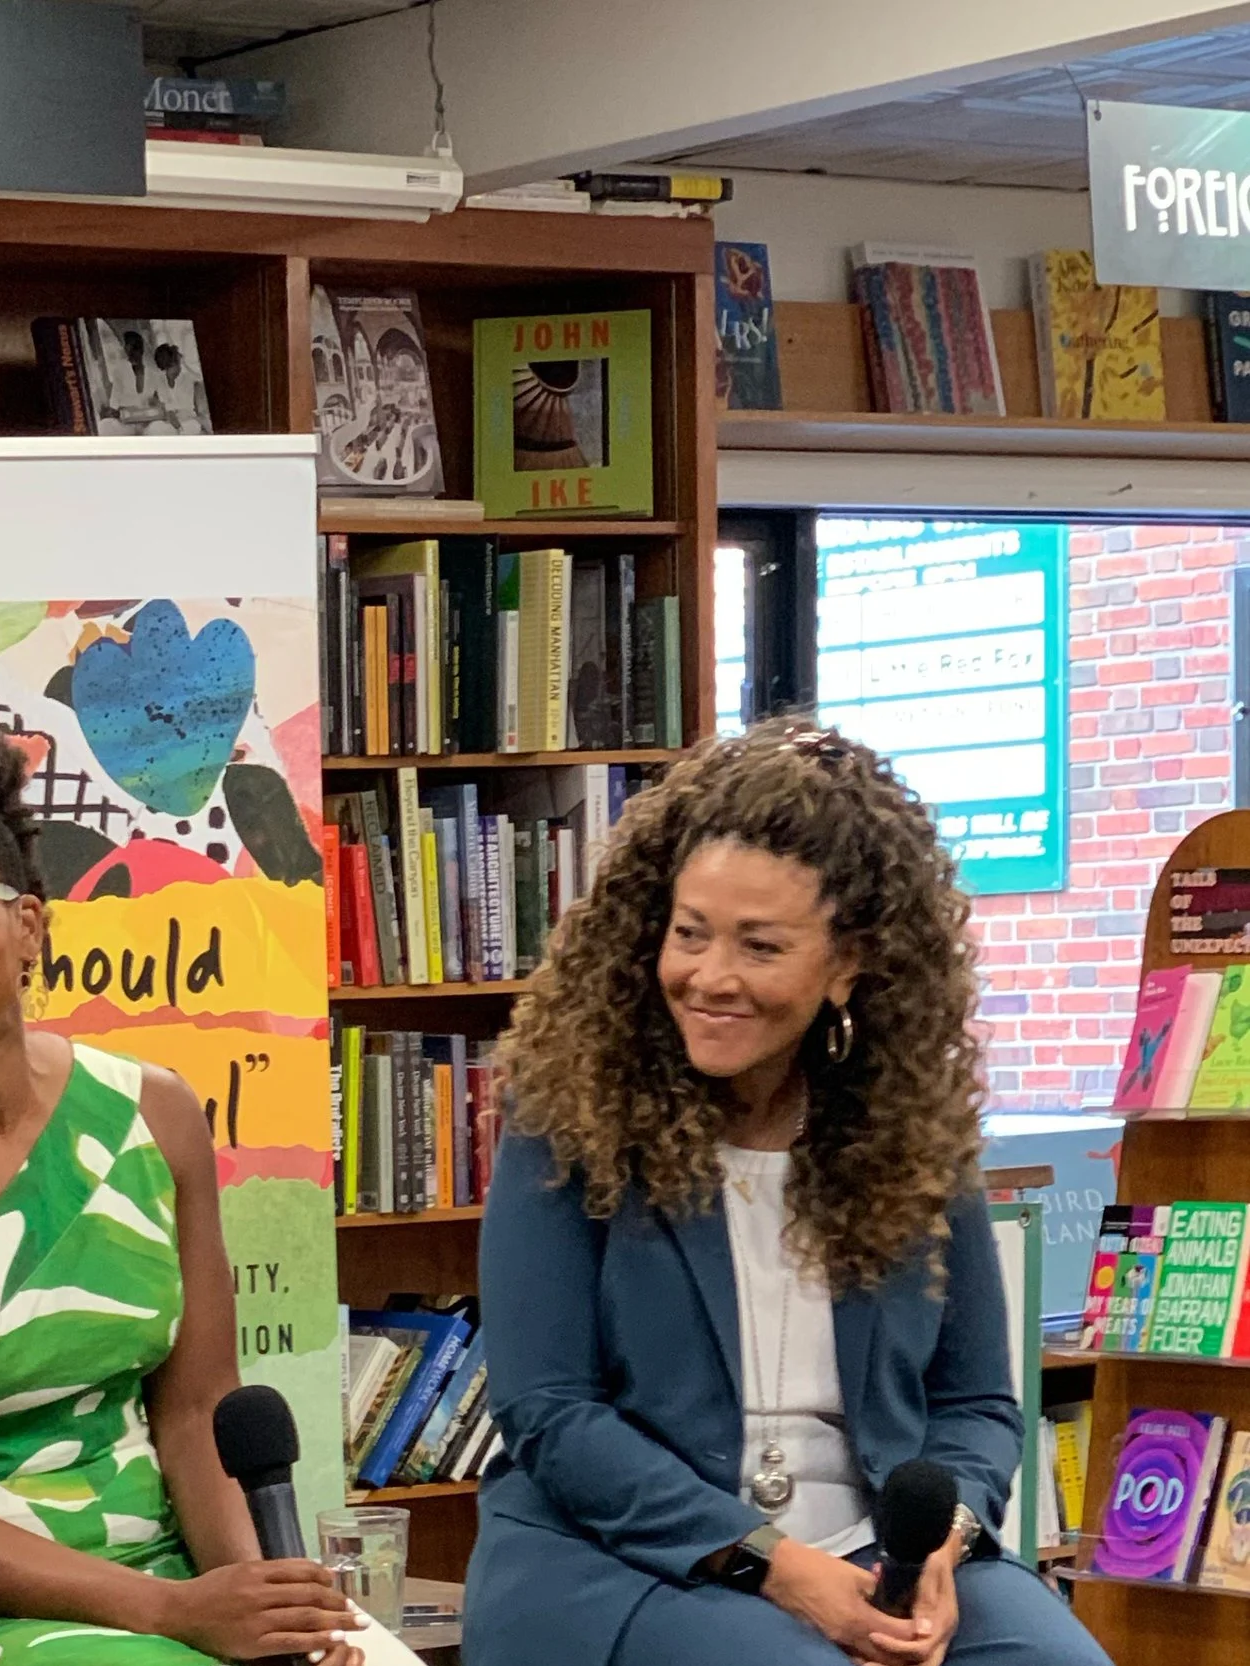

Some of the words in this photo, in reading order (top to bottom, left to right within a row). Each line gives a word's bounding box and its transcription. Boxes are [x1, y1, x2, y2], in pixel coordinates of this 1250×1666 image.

[514, 319, 610, 353] JOHN
[531, 477, 594, 508] IKE
[485, 542, 494, 616] Architecture
[550, 559, 564, 622] DECODING
[550, 626, 562, 701] MANHATTAN
[404, 779, 418, 826] Beyond
[364, 799, 387, 894] RECLAIMED
[408, 829, 419, 849] the
[406, 850, 420, 899] Canyon
[325, 873, 335, 917] ICONIC
[43, 917, 225, 1008] hould
[330, 1063, 342, 1091] The
[1037, 1188, 1106, 1216] BIRD
[1170, 1209, 1243, 1239] EATING
[1166, 1239, 1239, 1268] ANIMALS
[1159, 1273, 1233, 1299] JONATHAN
[1155, 1299, 1228, 1327] SAFRAN
[1151, 1324, 1205, 1355] FOER
[1113, 1472, 1185, 1515] POD
